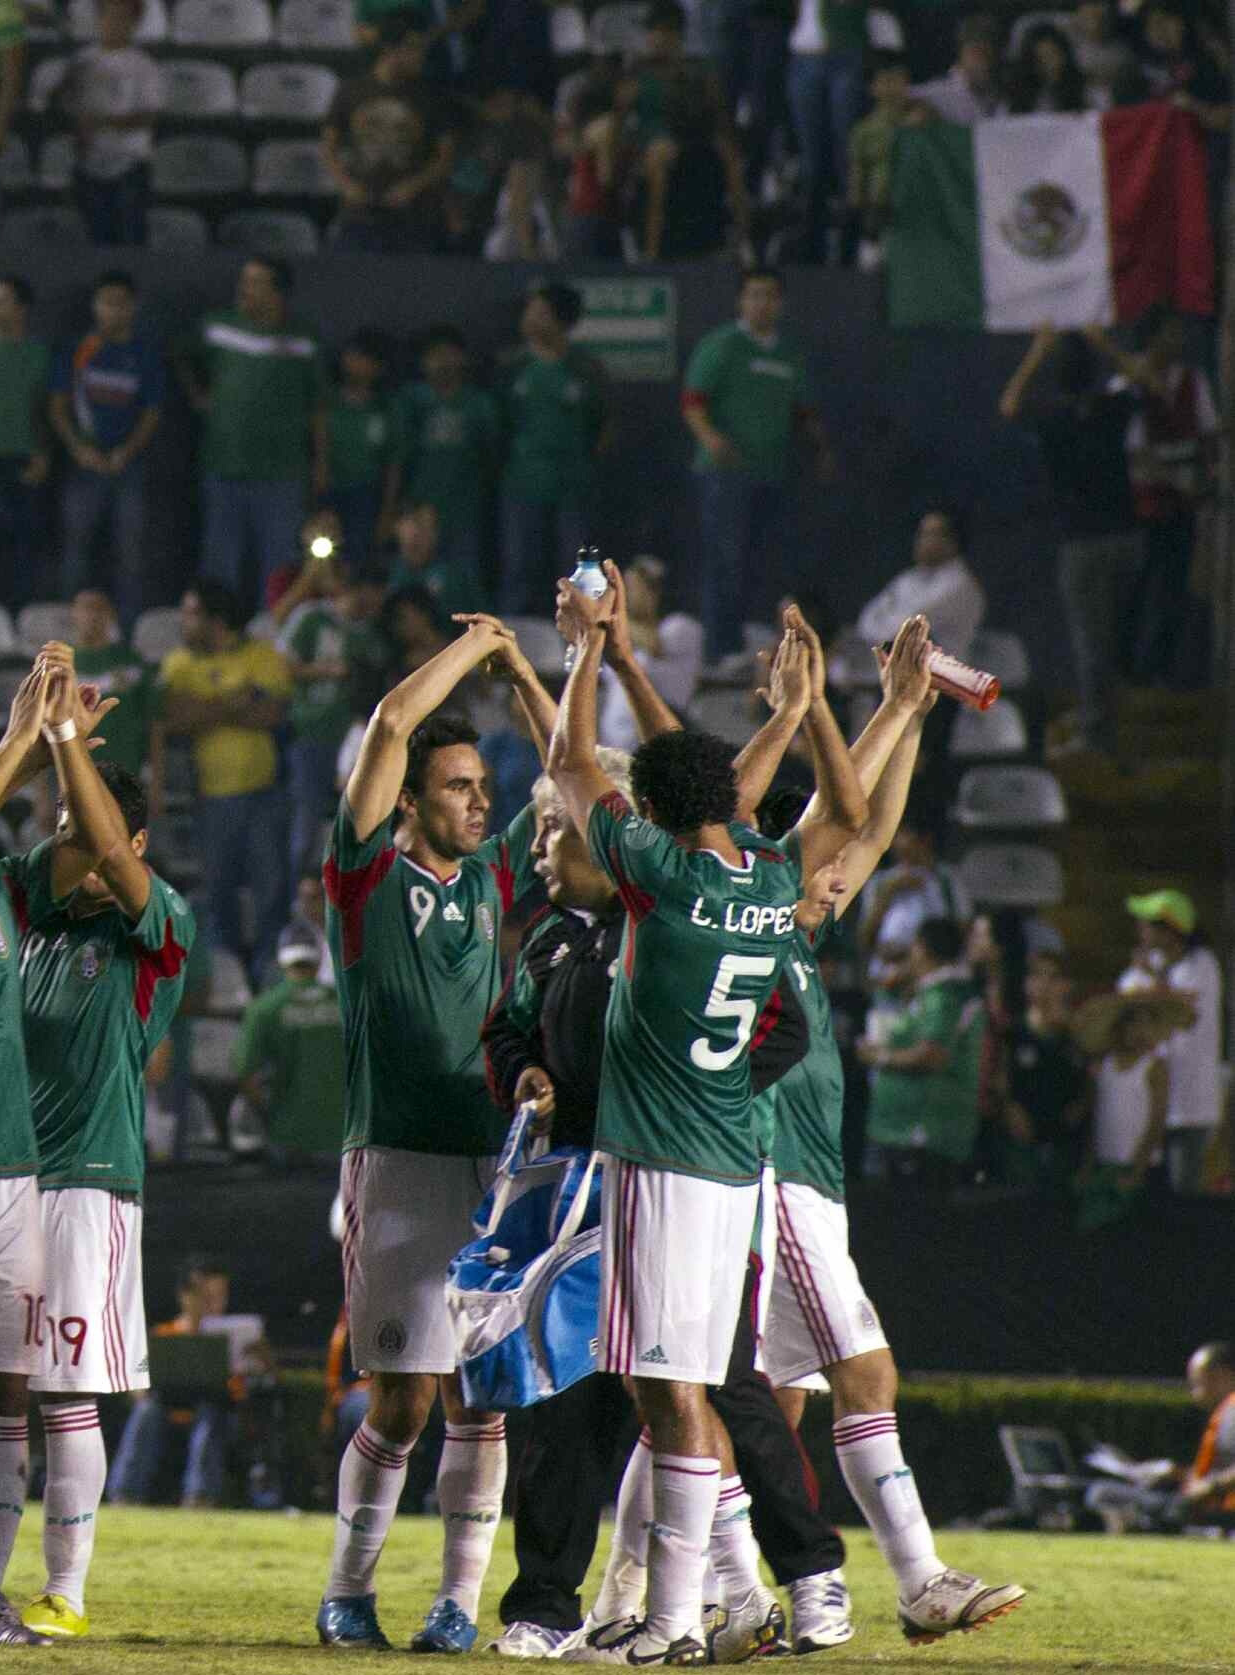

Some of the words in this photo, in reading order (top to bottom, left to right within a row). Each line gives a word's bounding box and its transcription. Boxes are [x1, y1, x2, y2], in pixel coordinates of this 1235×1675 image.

[410, 886, 436, 938] 9
[691, 897, 718, 928] L.
[690, 954, 776, 1071] 5
[46, 1316, 87, 1366] 19
